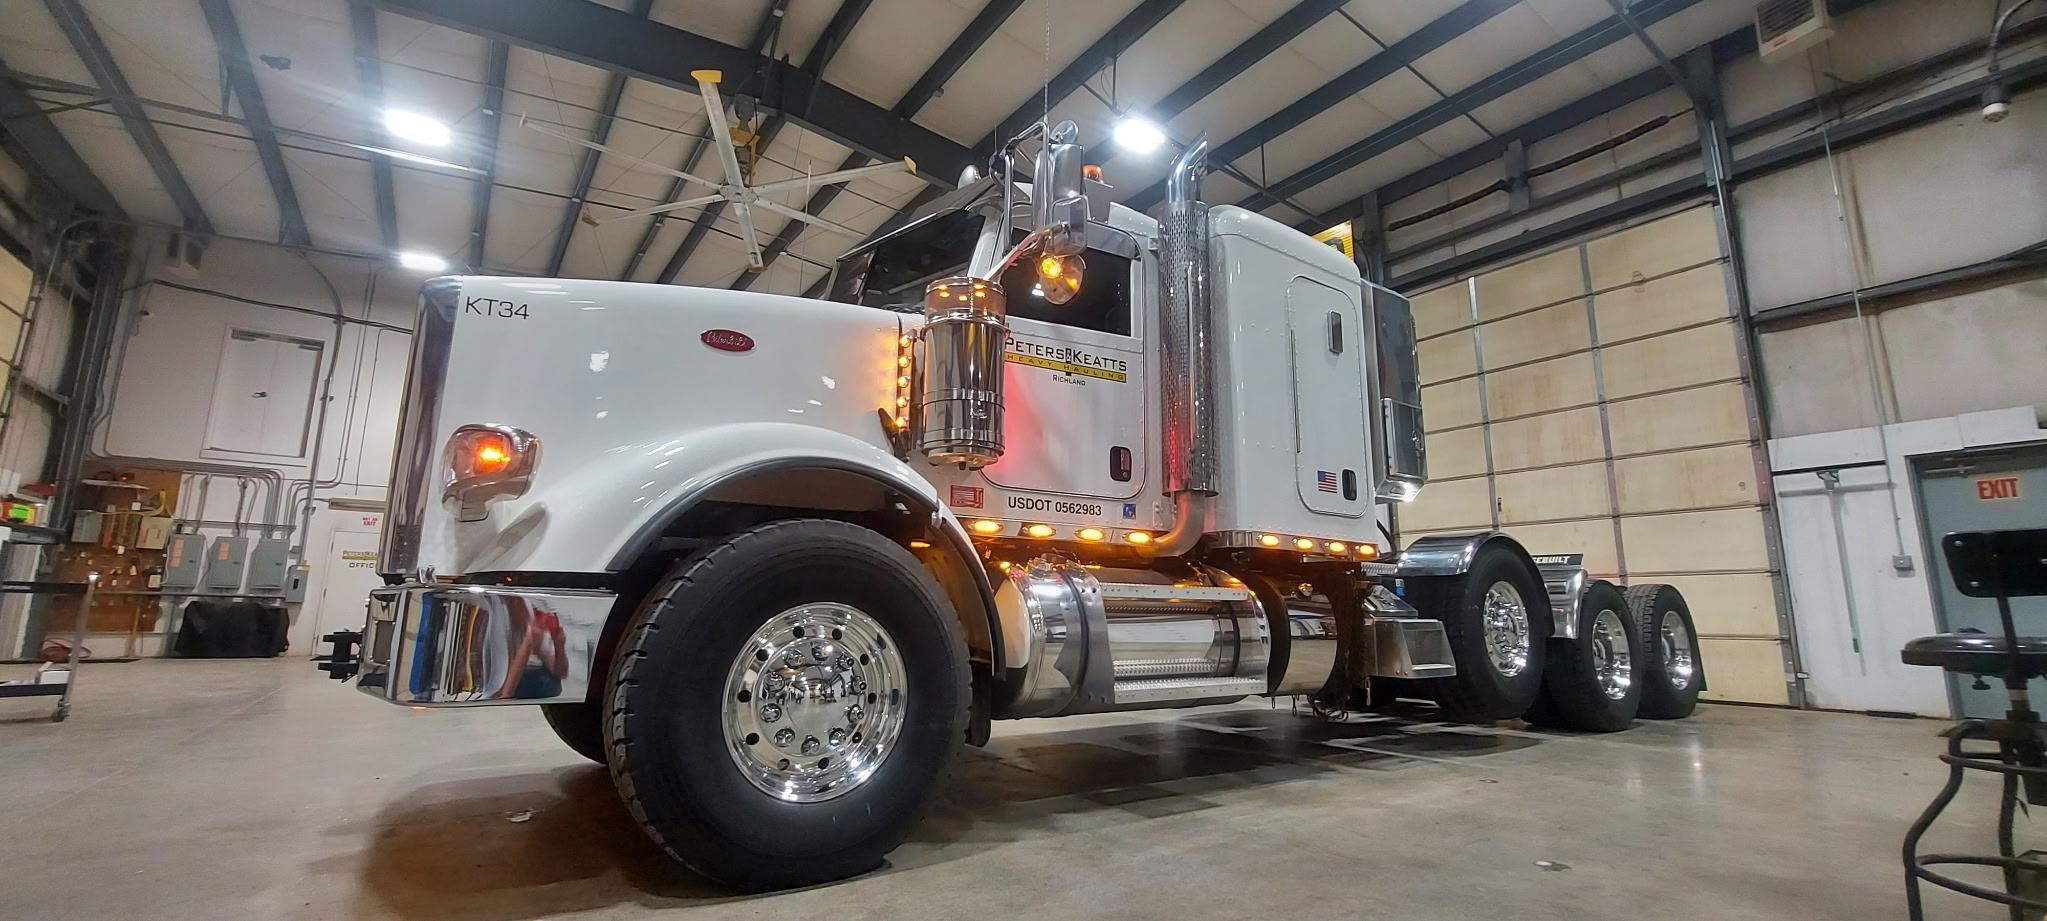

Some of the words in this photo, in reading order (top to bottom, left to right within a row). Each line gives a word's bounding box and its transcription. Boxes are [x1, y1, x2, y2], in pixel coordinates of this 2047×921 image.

[465, 296, 530, 320] KT34
[1007, 354, 1052, 367] HEAVY
[1063, 365, 1124, 381] HAULING
[1073, 350, 1127, 372] KEATTS
[1977, 478, 2018, 499] EXIT
[1008, 496, 1052, 511] USDOT
[1055, 501, 1102, 516] 0562983
